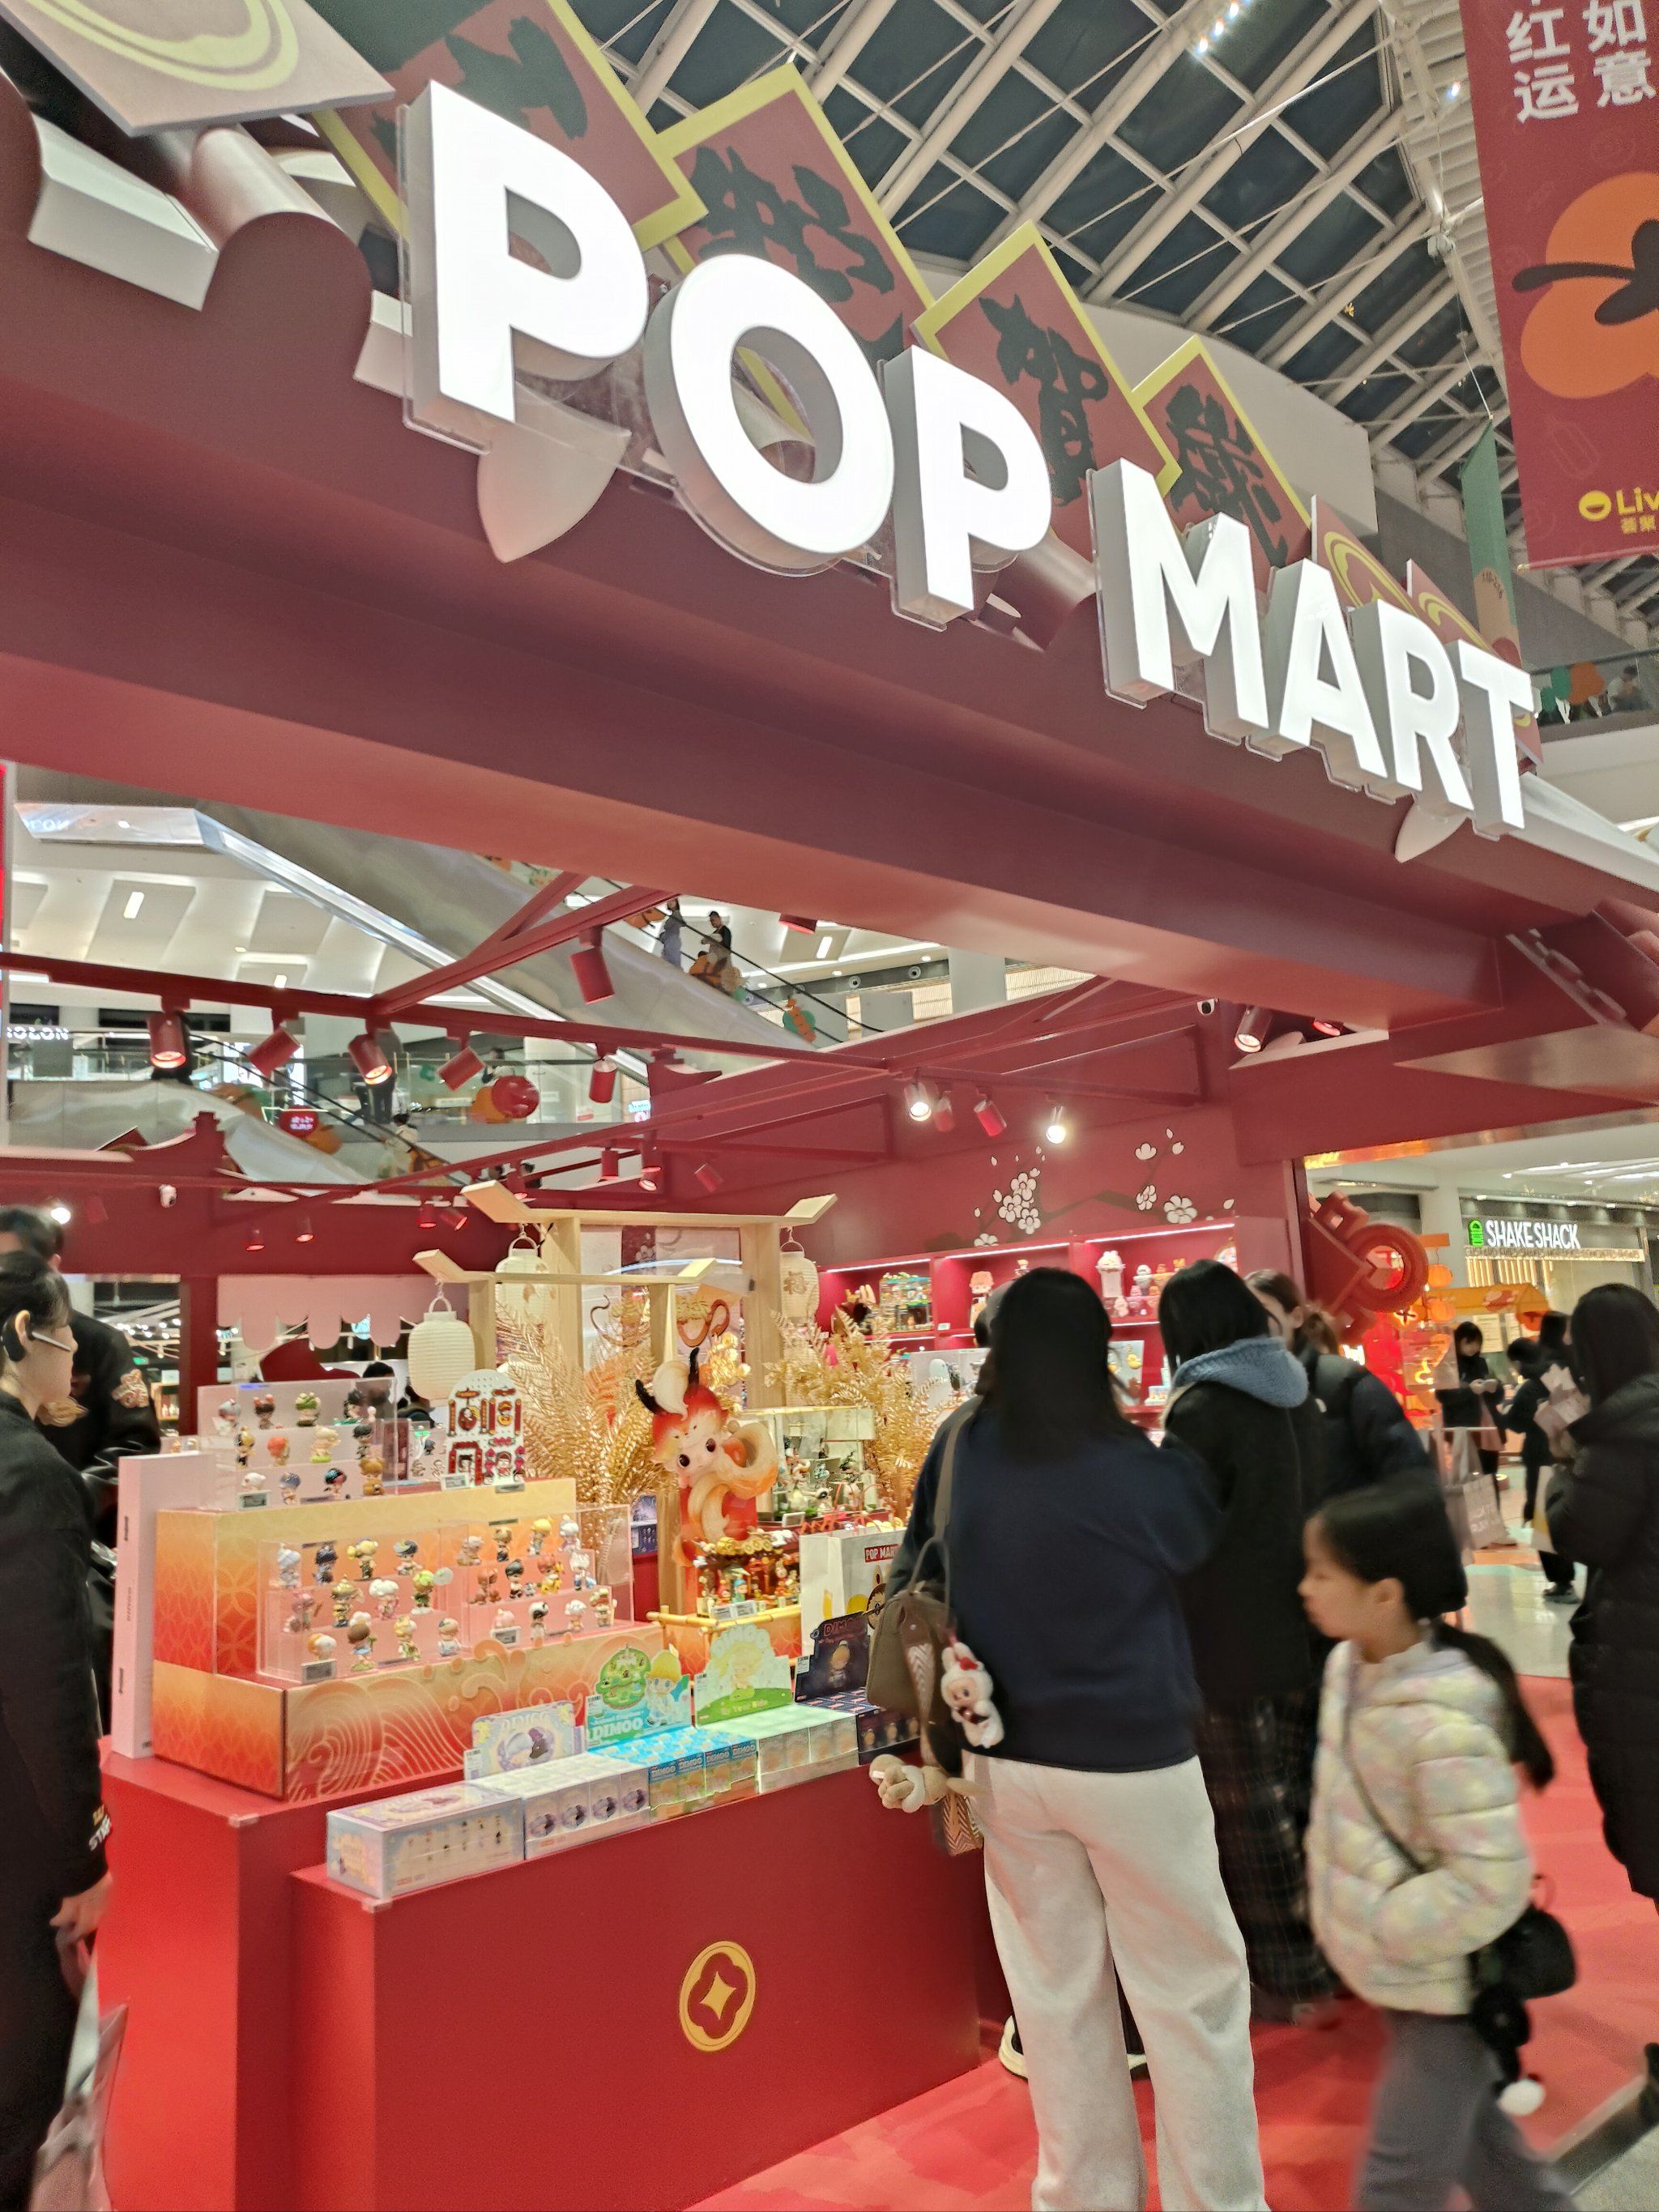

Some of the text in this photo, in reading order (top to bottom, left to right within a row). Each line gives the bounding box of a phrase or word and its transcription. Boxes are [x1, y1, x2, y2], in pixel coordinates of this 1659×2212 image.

[423, 79, 1053, 614] POP
[1111, 457, 1533, 831] MART
[1485, 1219, 1580, 1250] SHAKE SHACK
[865, 1545, 898, 1562] POP MAR
[823, 1616, 864, 1637] DIMO
[592, 1716, 644, 1741] DIMOO
